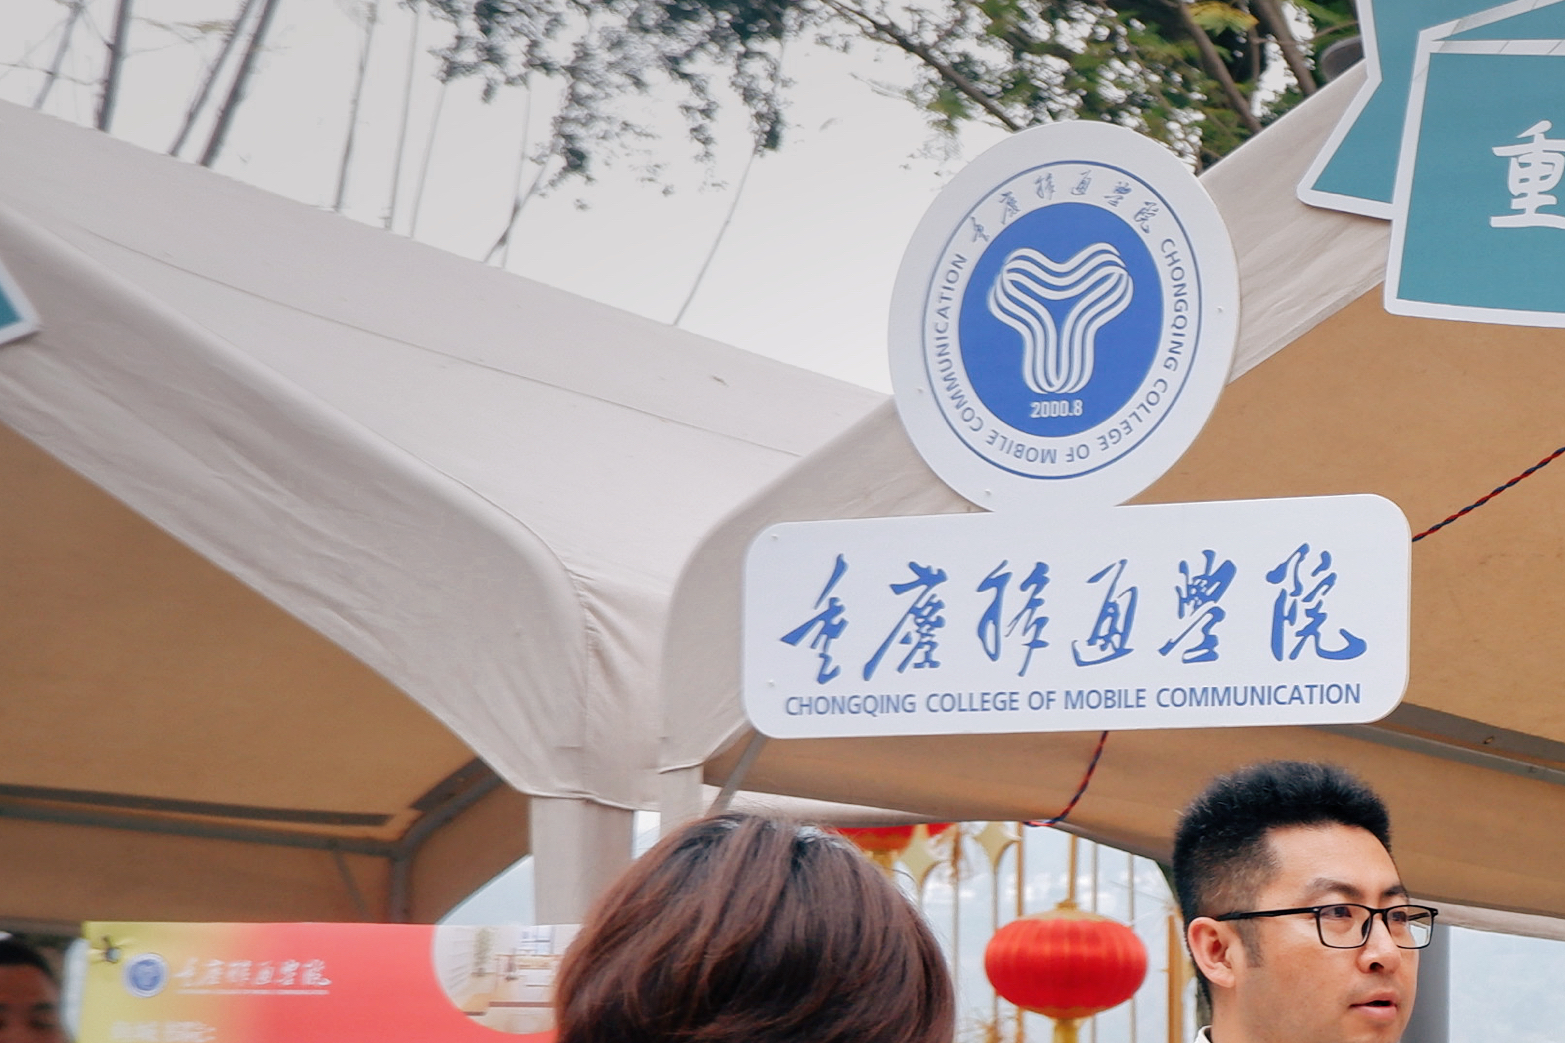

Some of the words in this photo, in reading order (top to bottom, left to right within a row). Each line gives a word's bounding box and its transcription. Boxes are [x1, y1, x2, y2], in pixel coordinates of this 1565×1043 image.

[1161, 237, 1190, 373] CHONGQING
[934, 252, 986, 433] COMMUNICATION
[1030, 399, 1084, 419] 2000.8
[1099, 377, 1168, 451] COLLEGE
[985, 428, 1057, 464] MOBILE
[1065, 442, 1090, 463] OF
[785, 693, 917, 717] CHONGQING
[925, 690, 1020, 713] COLLEGE
[1027, 688, 1056, 711] OF
[1063, 687, 1147, 710] MOBILE
[1155, 682, 1362, 709] COMMUNICATION
